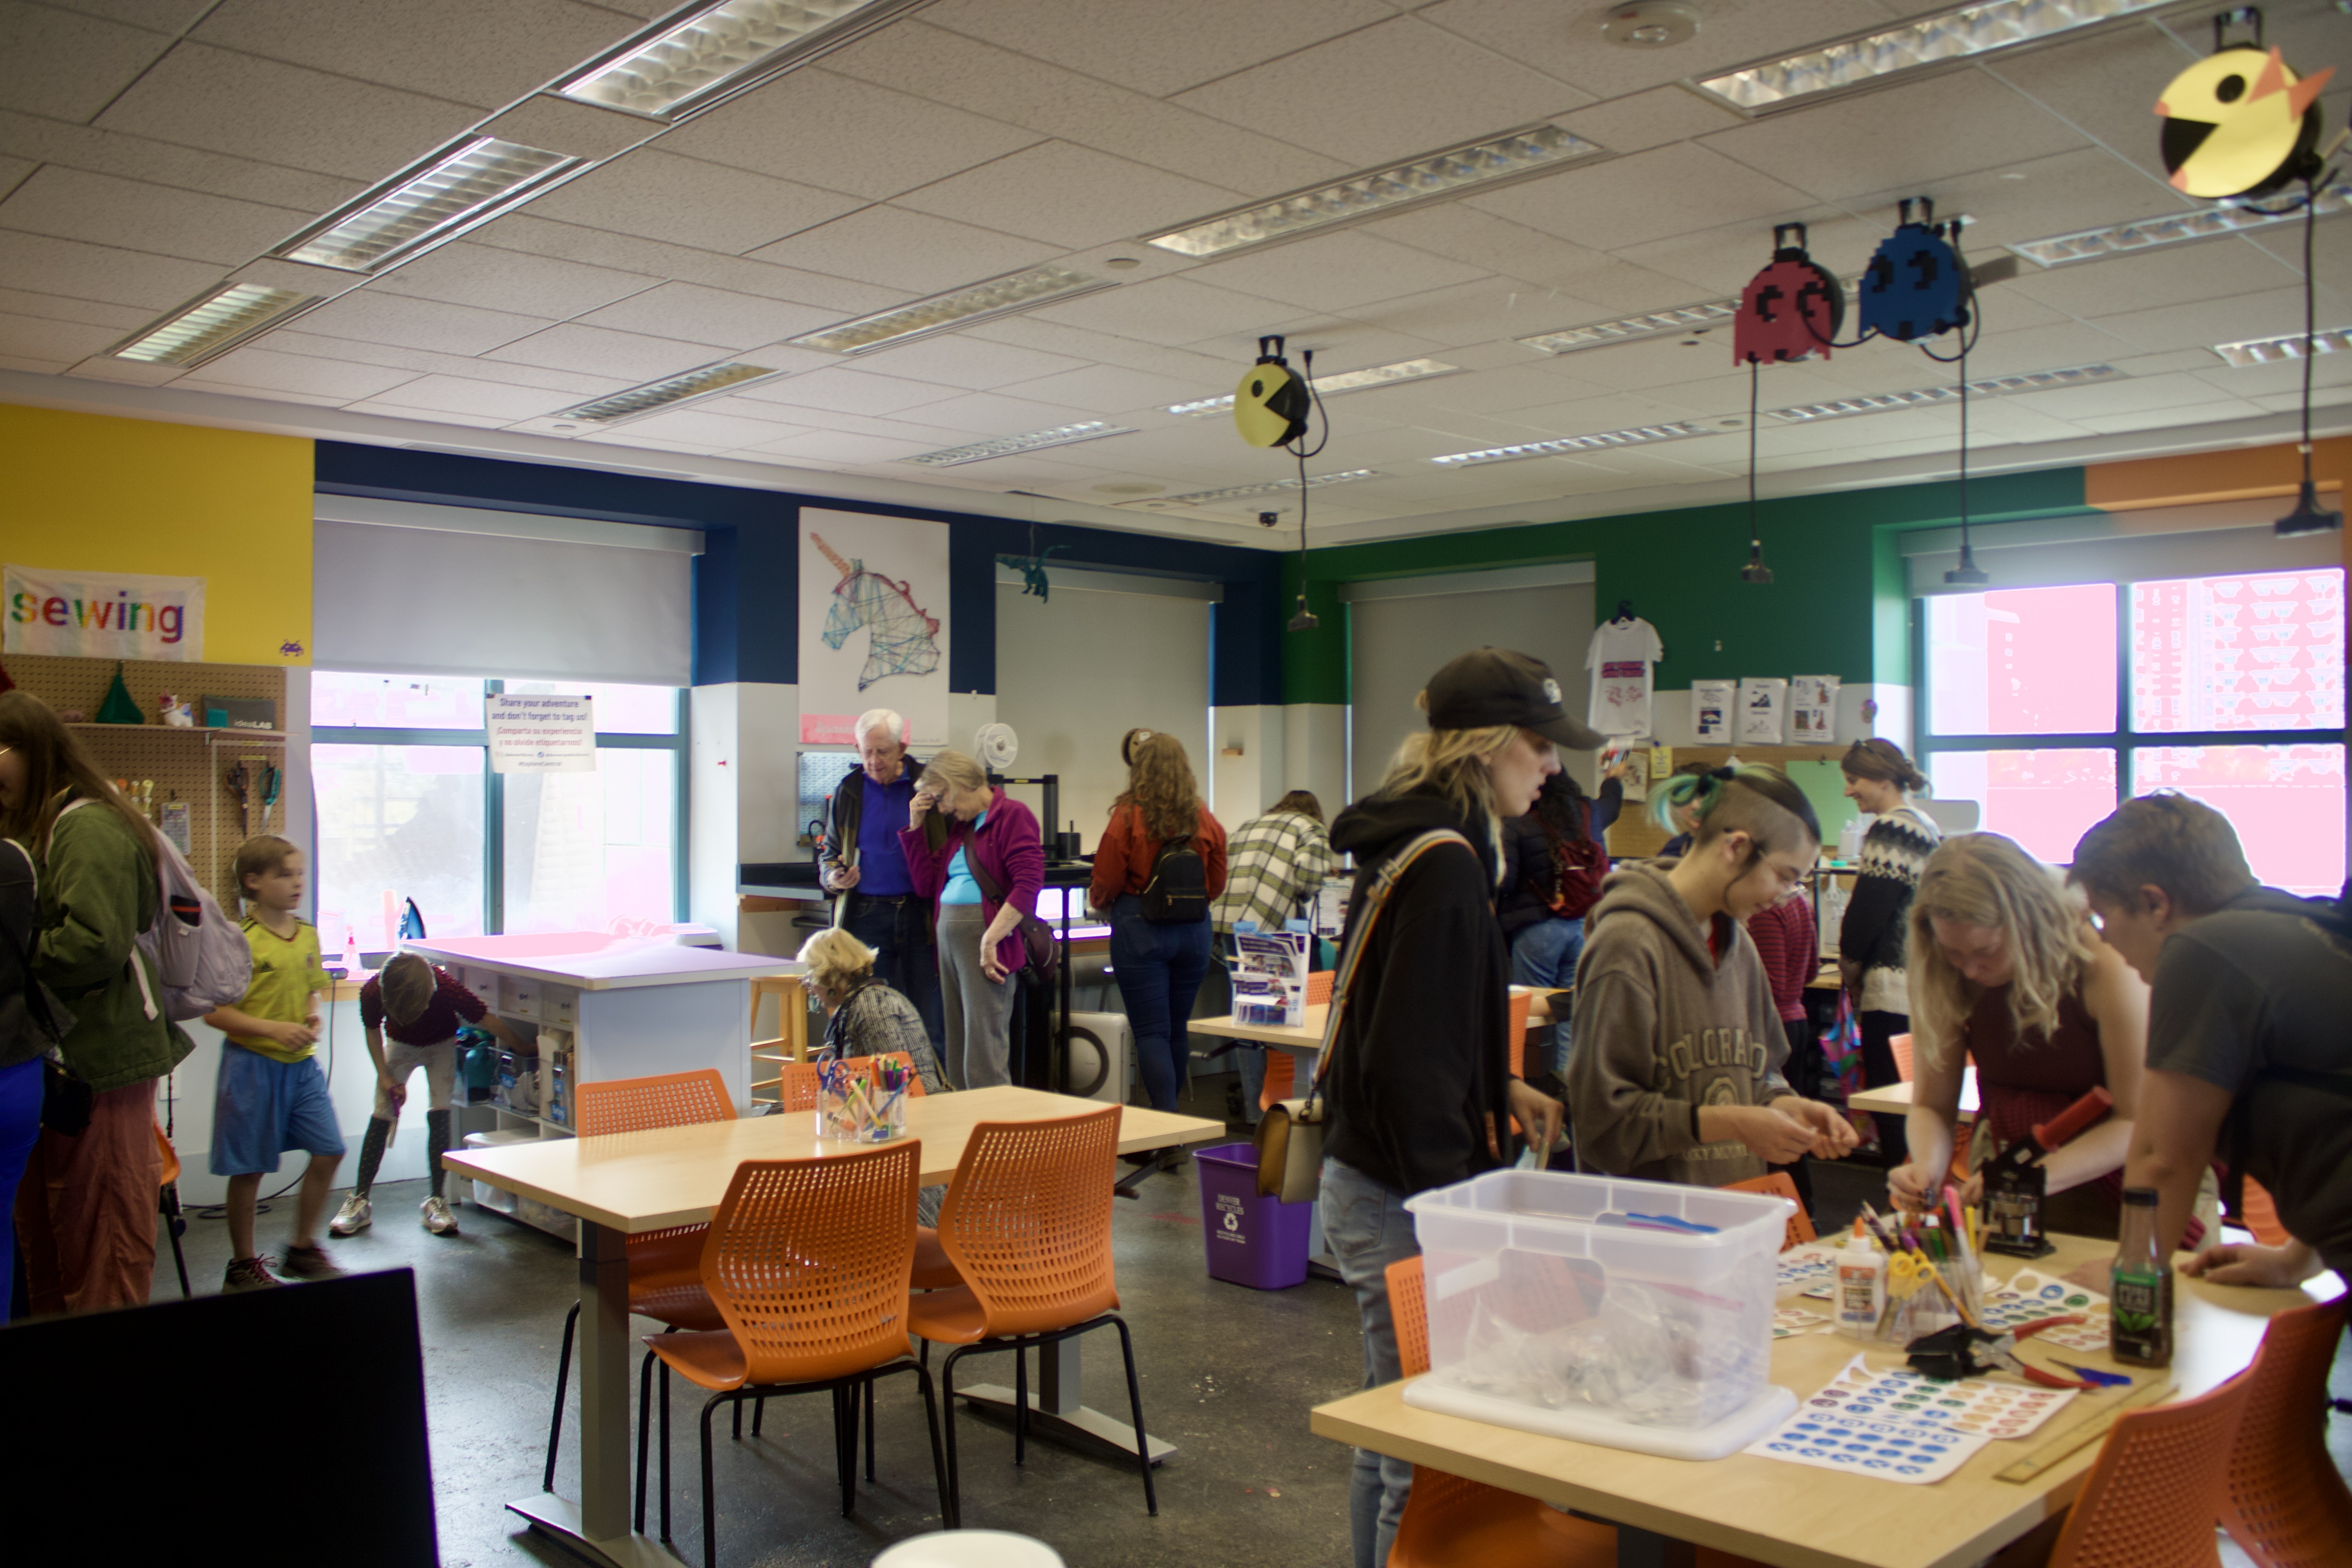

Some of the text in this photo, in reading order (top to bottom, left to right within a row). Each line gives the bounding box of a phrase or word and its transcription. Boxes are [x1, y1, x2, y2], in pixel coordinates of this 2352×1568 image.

[11, 591, 184, 643] sewing
[499, 698, 579, 708] Share your adventure
[507, 712, 526, 720] don't
[528, 712, 552, 722] forget
[562, 713, 575, 722] tag
